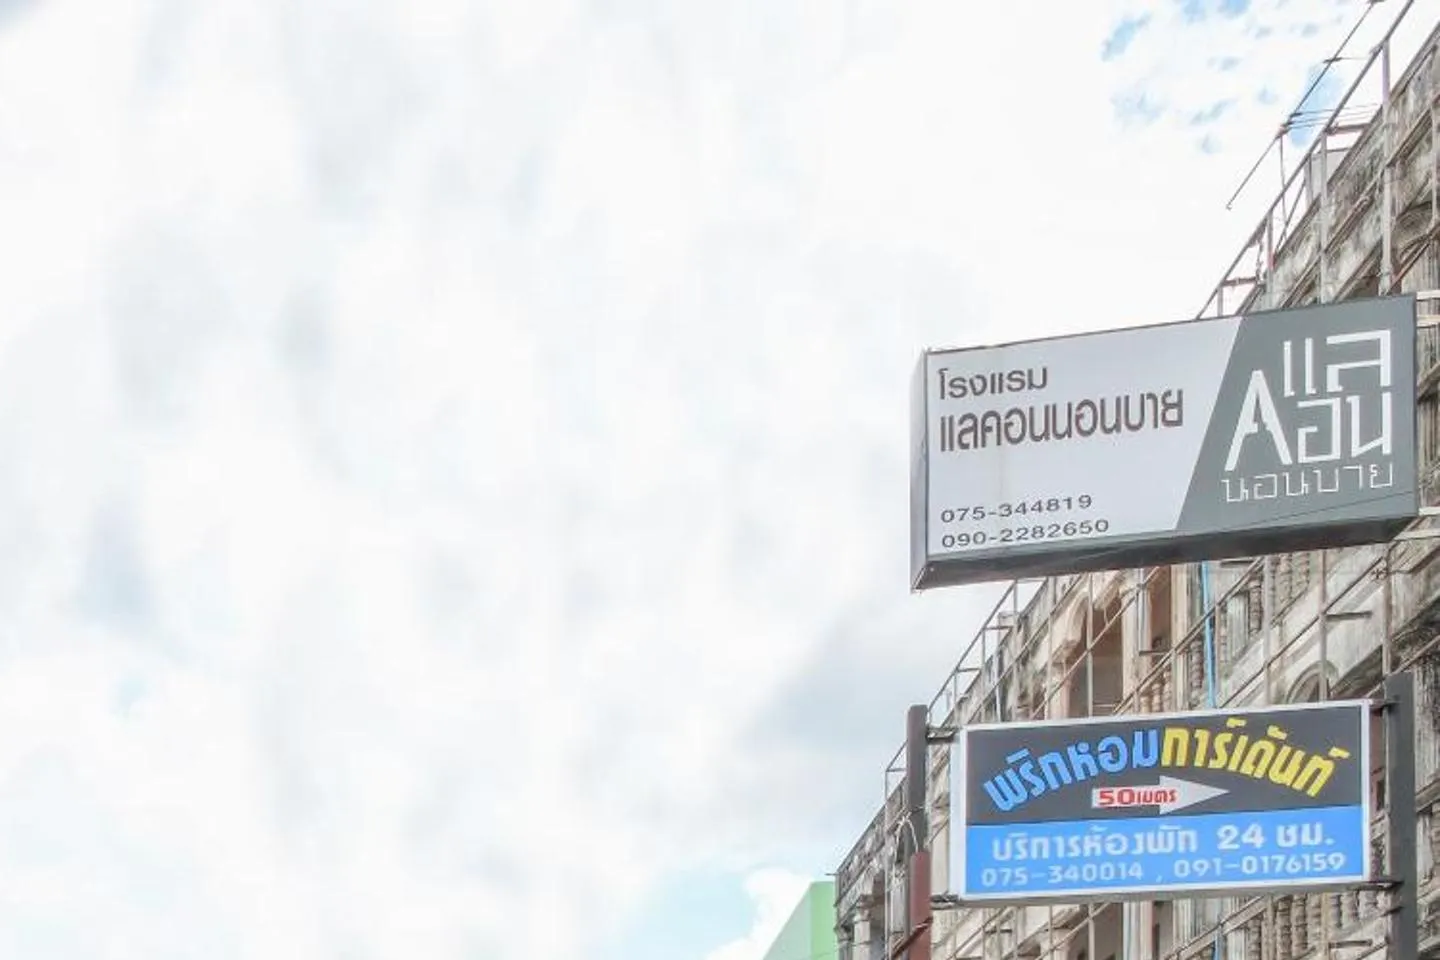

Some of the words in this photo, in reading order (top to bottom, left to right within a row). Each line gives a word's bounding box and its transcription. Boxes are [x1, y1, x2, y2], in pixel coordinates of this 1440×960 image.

[938, 366, 1048, 400] โรงแรม
[939, 388, 1184, 452] แลคอนนอนบาย
[1220, 462, 1393, 503] นอนบาย
[940, 494, 1093, 523] 075-344819
[941, 519, 1110, 548] 090-2282650
[992, 825, 1198, 862] บริการห้องพัก
[1216, 822, 1265, 850] 24
[1276, 821, 1335, 848] ชม.
[982, 862, 1143, 887] 075-340014
[1173, 851, 1347, 878] 091-0176159
